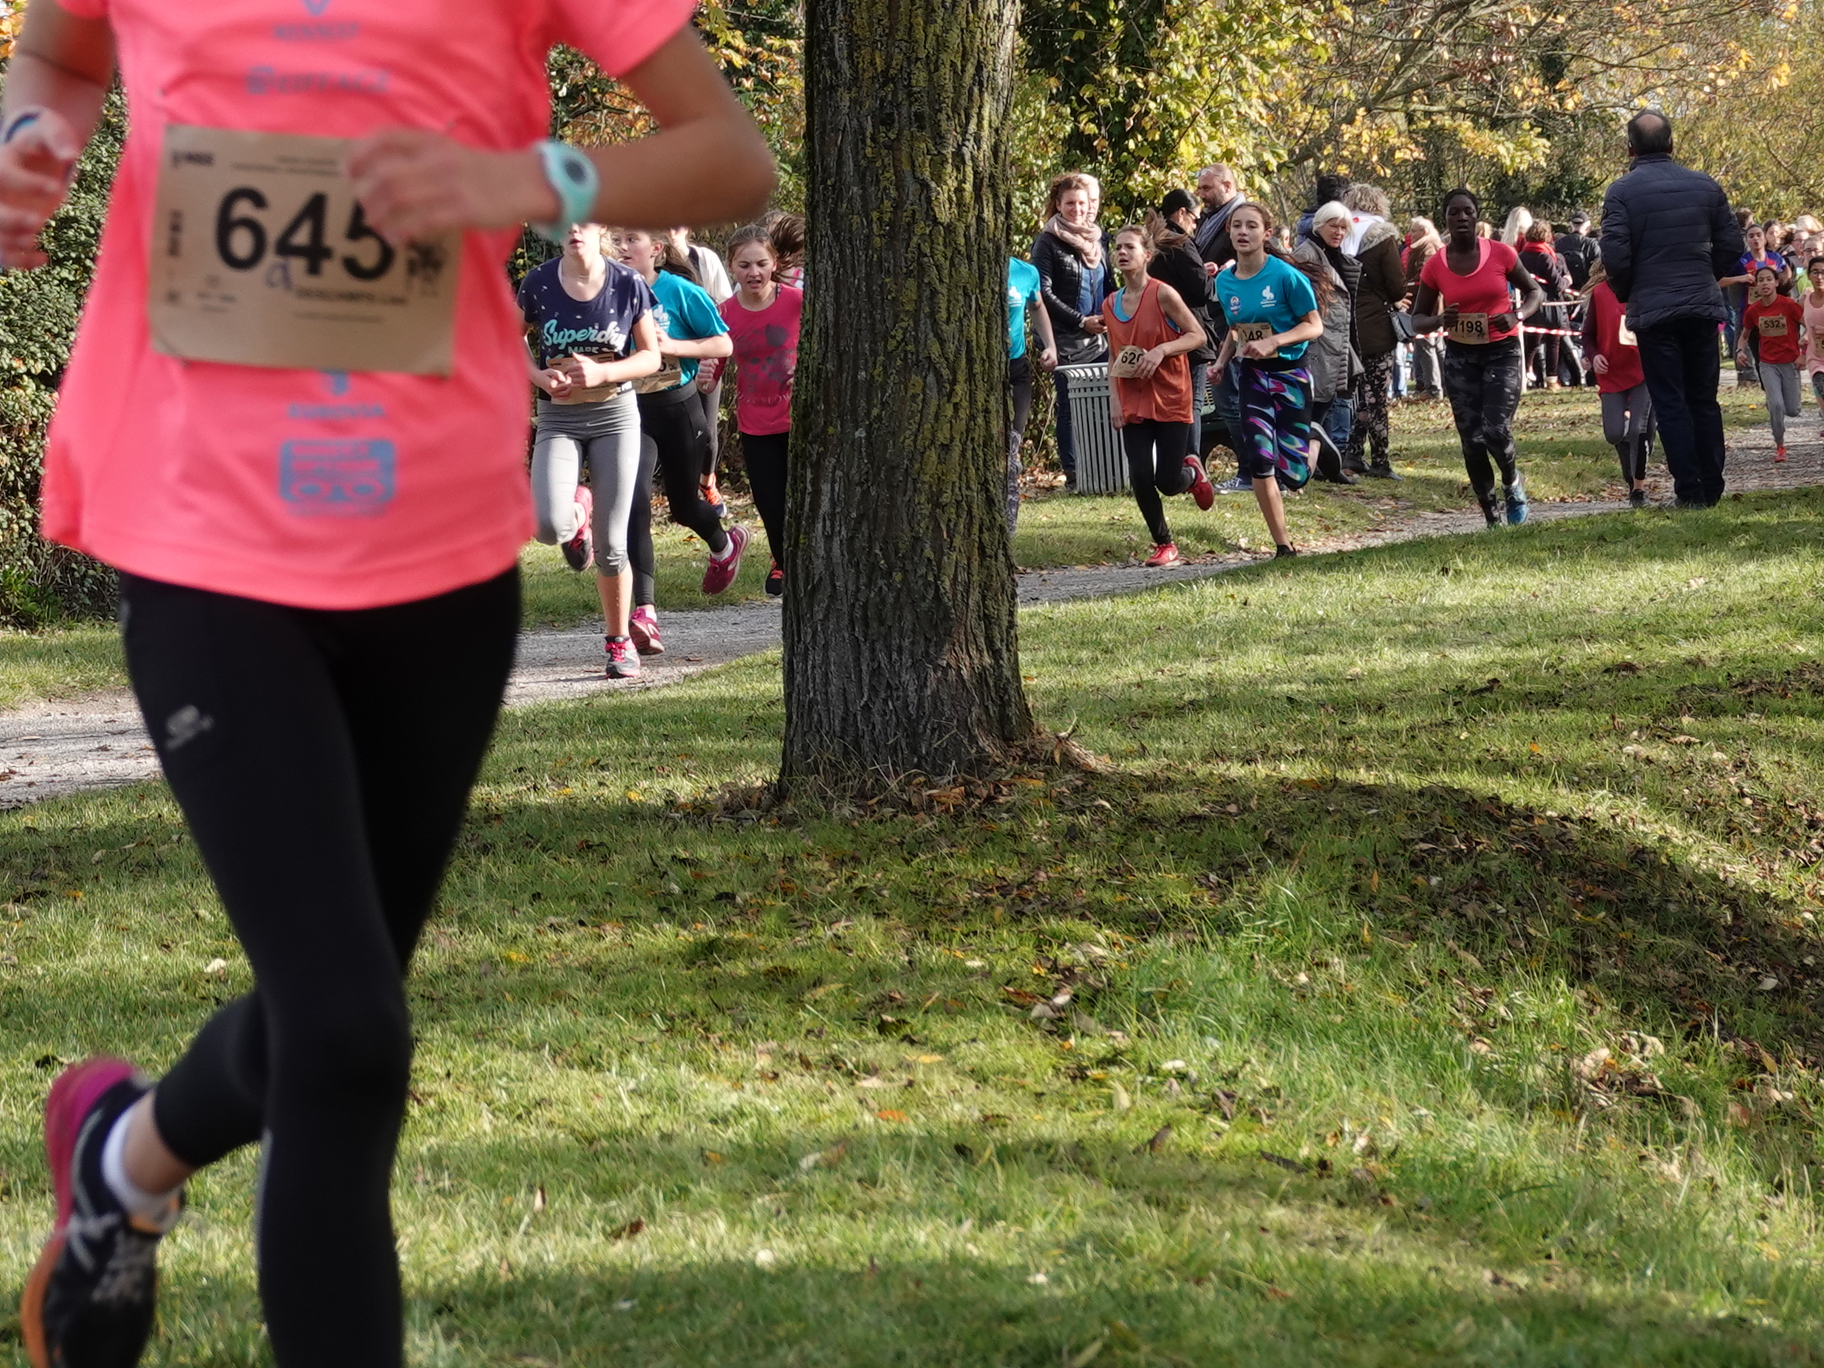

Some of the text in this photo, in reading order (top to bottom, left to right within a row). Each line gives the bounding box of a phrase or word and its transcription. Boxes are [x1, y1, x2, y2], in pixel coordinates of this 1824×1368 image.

[216, 186, 396, 281] 645
[543, 319, 627, 356] Superdry
[1764, 319, 1781, 329] 532
